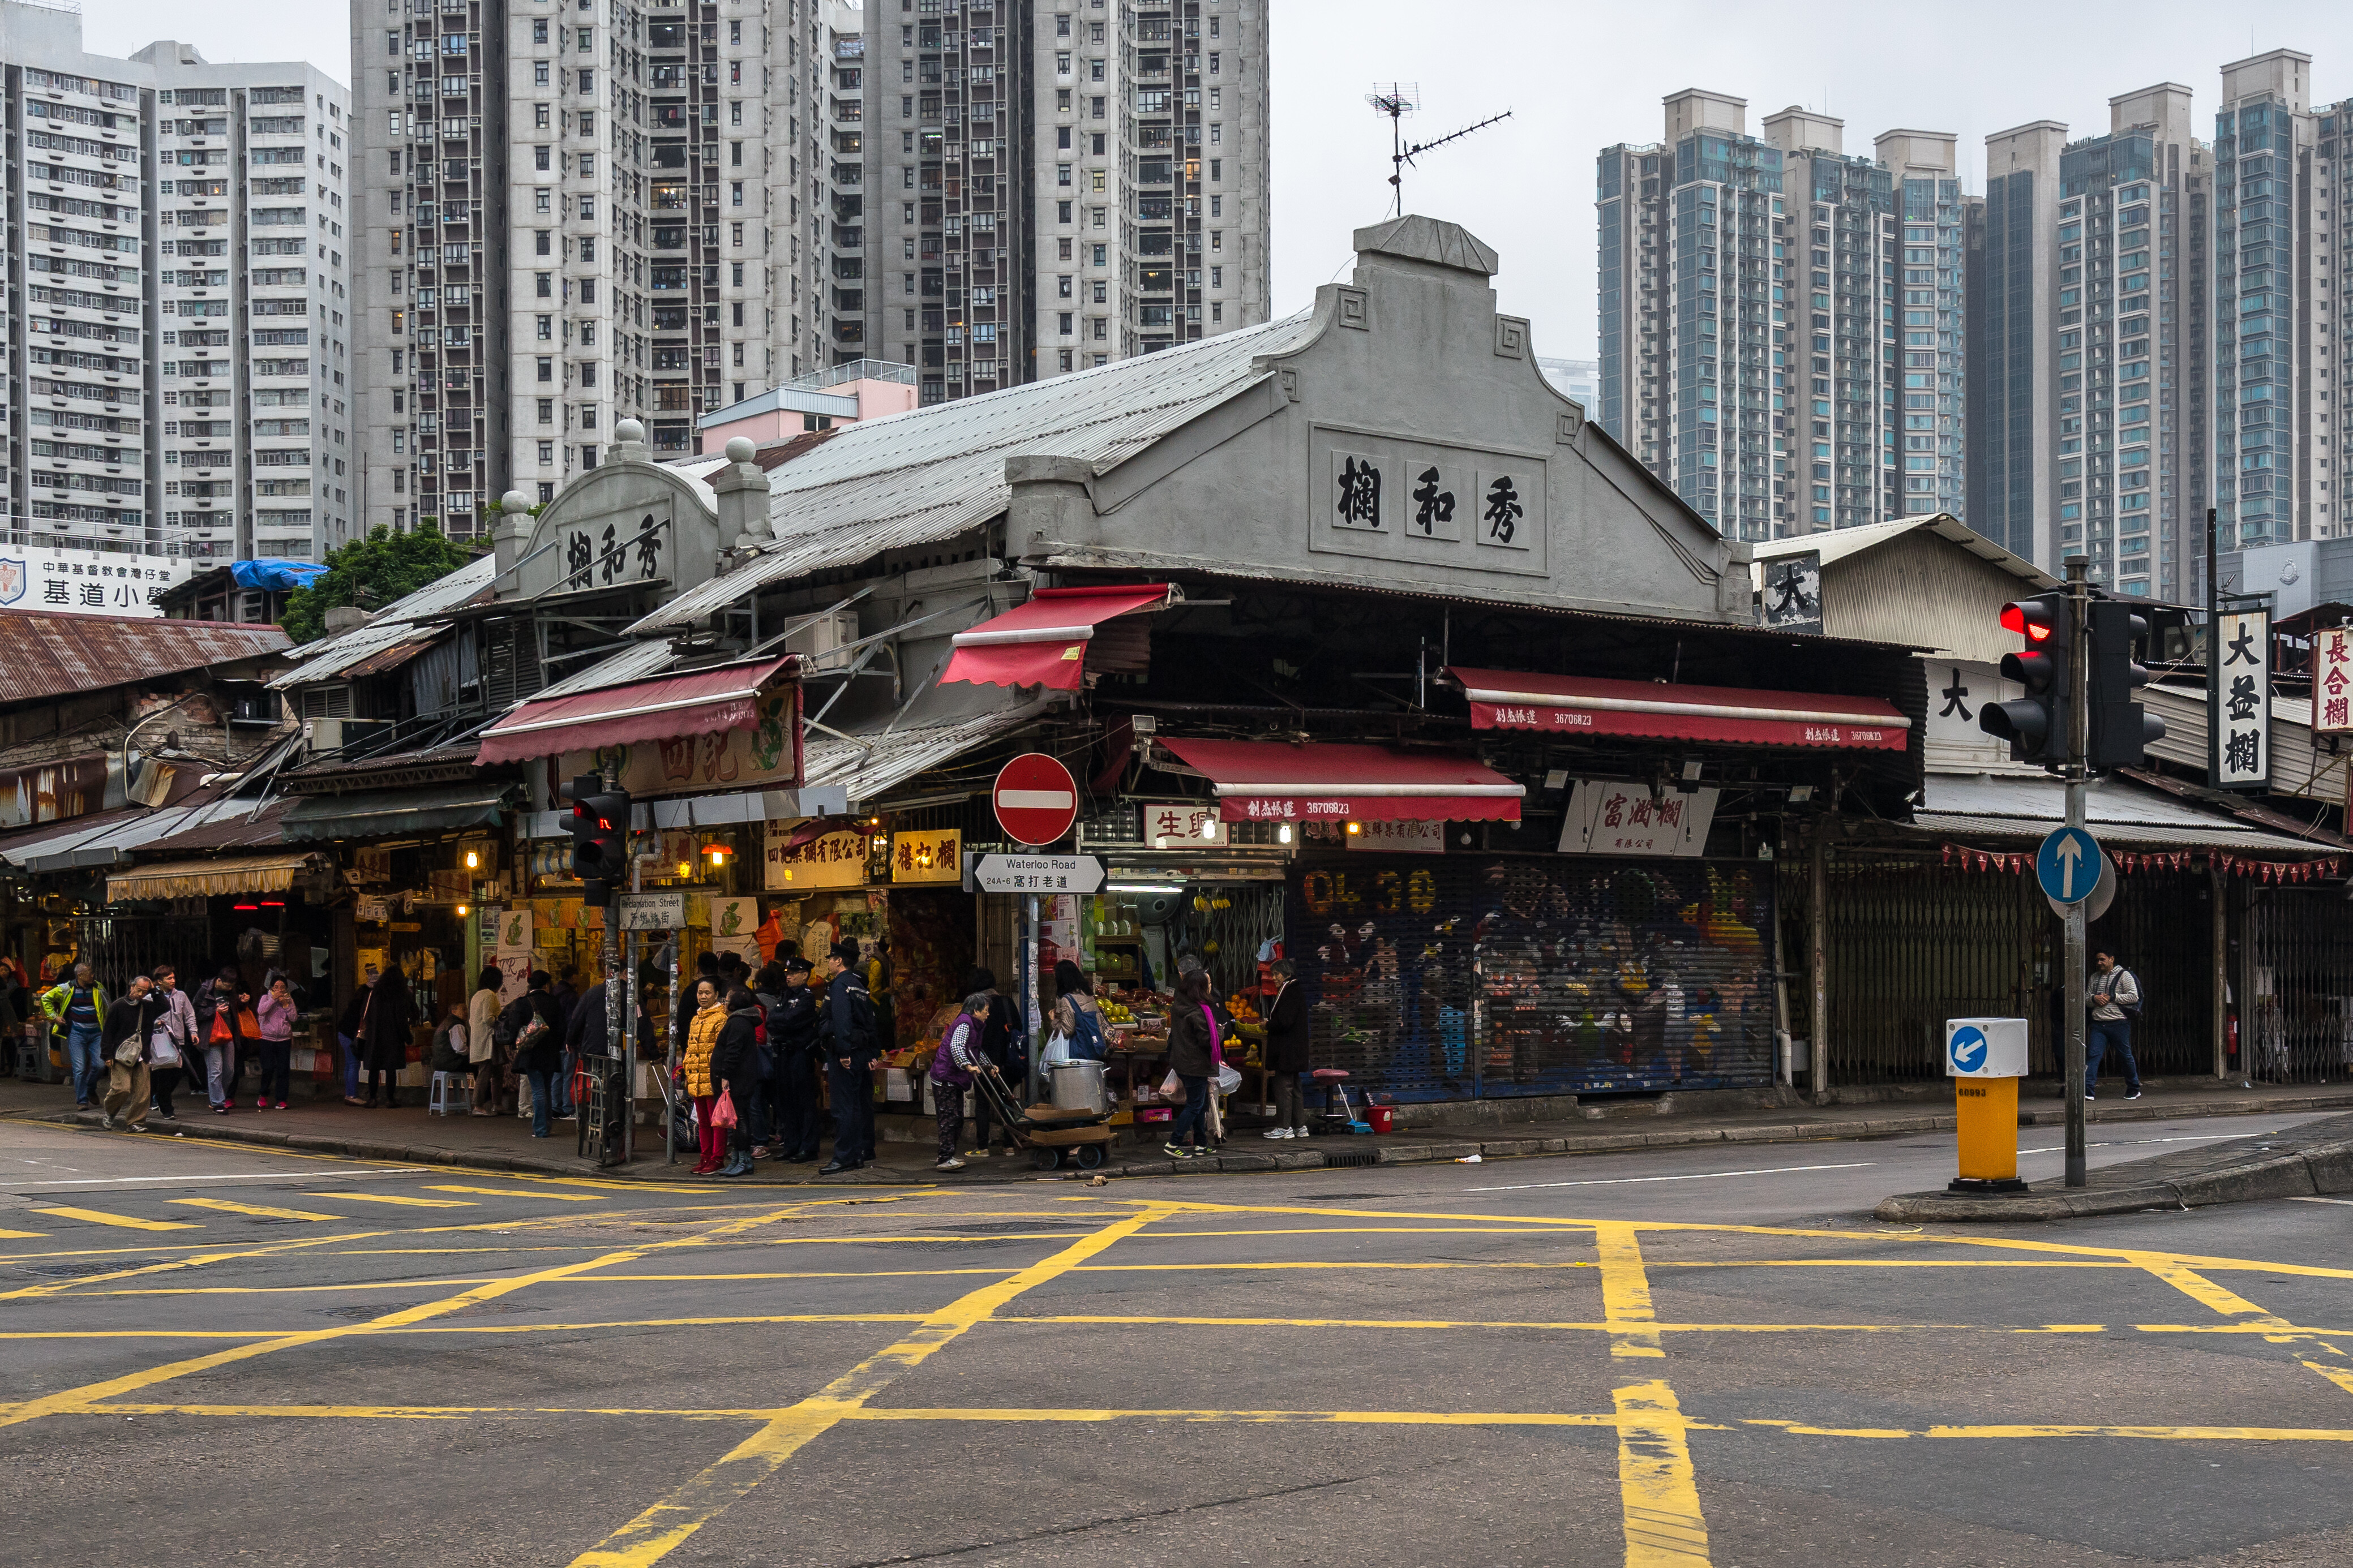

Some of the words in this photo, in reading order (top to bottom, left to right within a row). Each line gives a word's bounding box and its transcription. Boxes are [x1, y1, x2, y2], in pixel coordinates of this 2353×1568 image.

[1773, 563, 1809, 612] 大
[2322, 633, 2351, 726] 長合欄
[1939, 668, 1973, 722] 大
[2223, 622, 2261, 774] 大益欄
[1554, 713, 1592, 725] 36706823
[1851, 731, 1882, 741] 36706823
[1306, 802, 1349, 814] 36706823
[1615, 838, 1653, 849] 有限公司
[1006, 858, 1048, 869] Waterloo
[1051, 860, 1076, 870] Road
[1014, 875, 1068, 888] 窩打老道
[622, 899, 656, 909] Reclamation
[659, 897, 679, 907] Street
[1958, 1088, 1986, 1097] 60993
